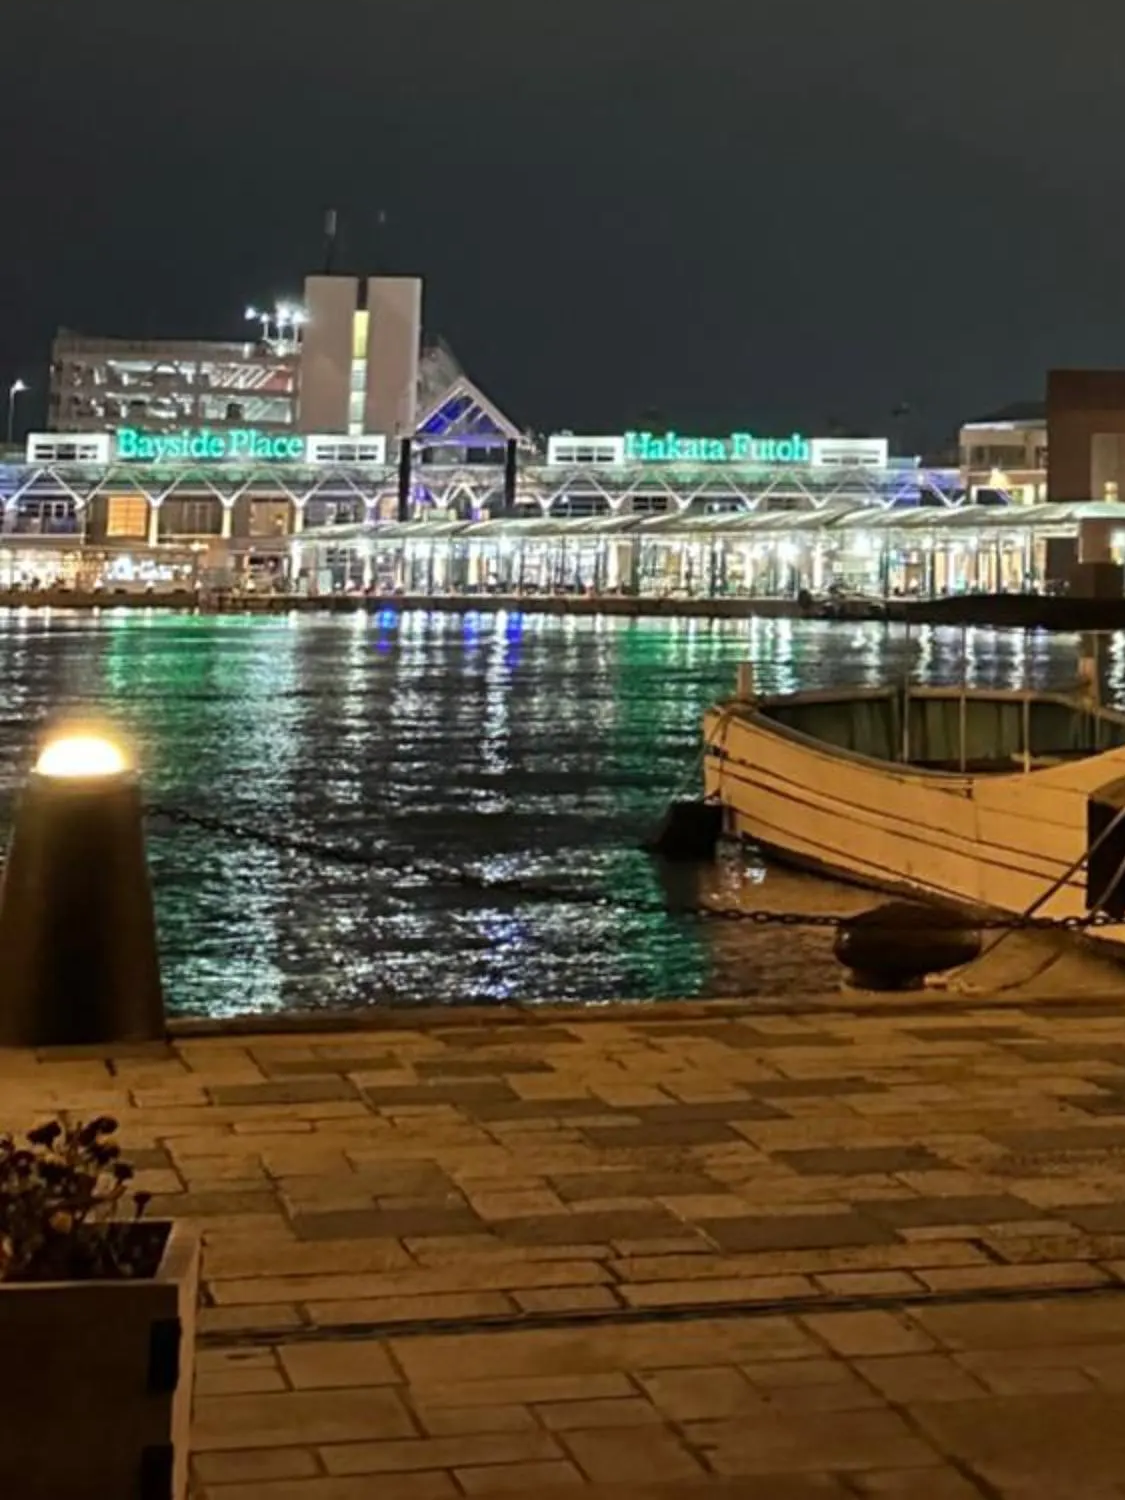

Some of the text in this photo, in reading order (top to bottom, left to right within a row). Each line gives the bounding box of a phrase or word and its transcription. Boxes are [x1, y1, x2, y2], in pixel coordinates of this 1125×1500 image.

[117, 429, 304, 462] Bayside Place
[624, 431, 809, 461] Hakata Futoh
